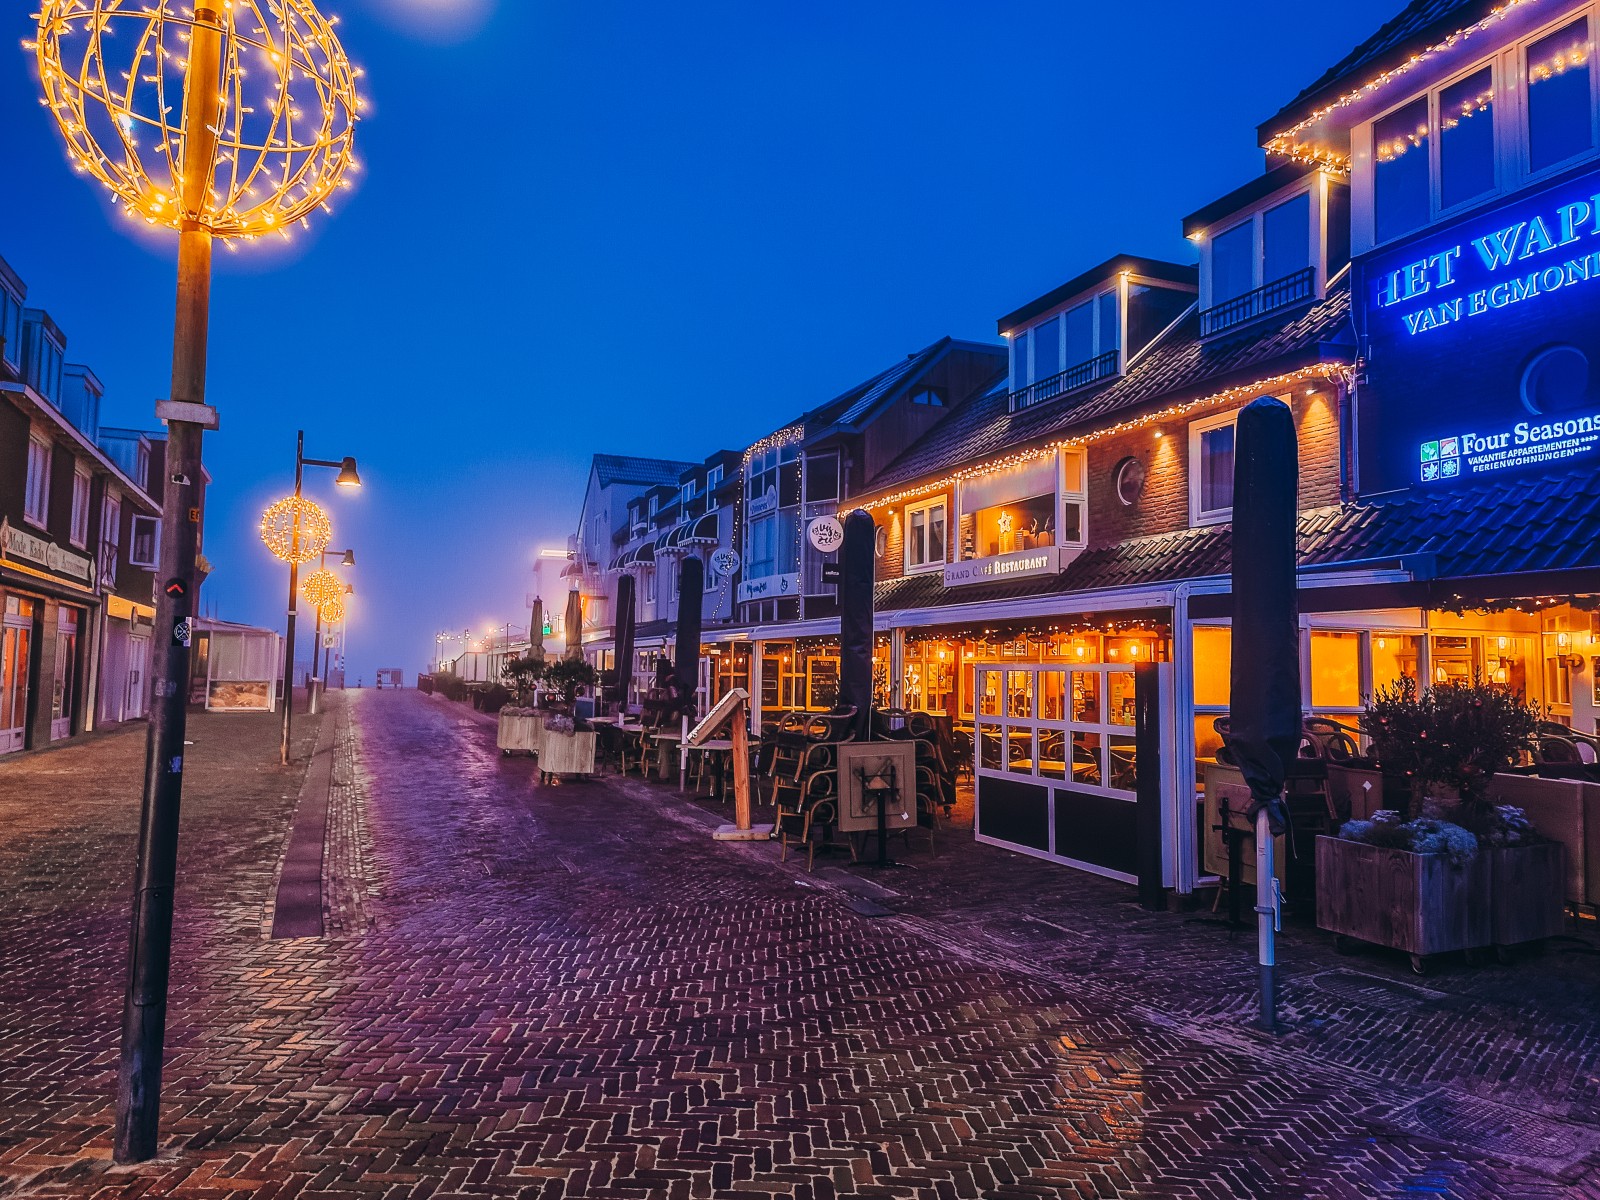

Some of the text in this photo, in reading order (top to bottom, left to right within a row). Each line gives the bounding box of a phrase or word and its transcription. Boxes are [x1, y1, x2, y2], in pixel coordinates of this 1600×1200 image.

[1377, 246, 1461, 308] HET
[1402, 298, 1463, 335] VAN
[1461, 432, 1511, 455] Four
[1467, 437, 1580, 466] VAKANTIE APPARTEMENTEN
[1473, 449, 1575, 473] FERIENWOHNUNGEN
[945, 569, 970, 581] GRAND
[994, 556, 1048, 575] RESTAURANT
